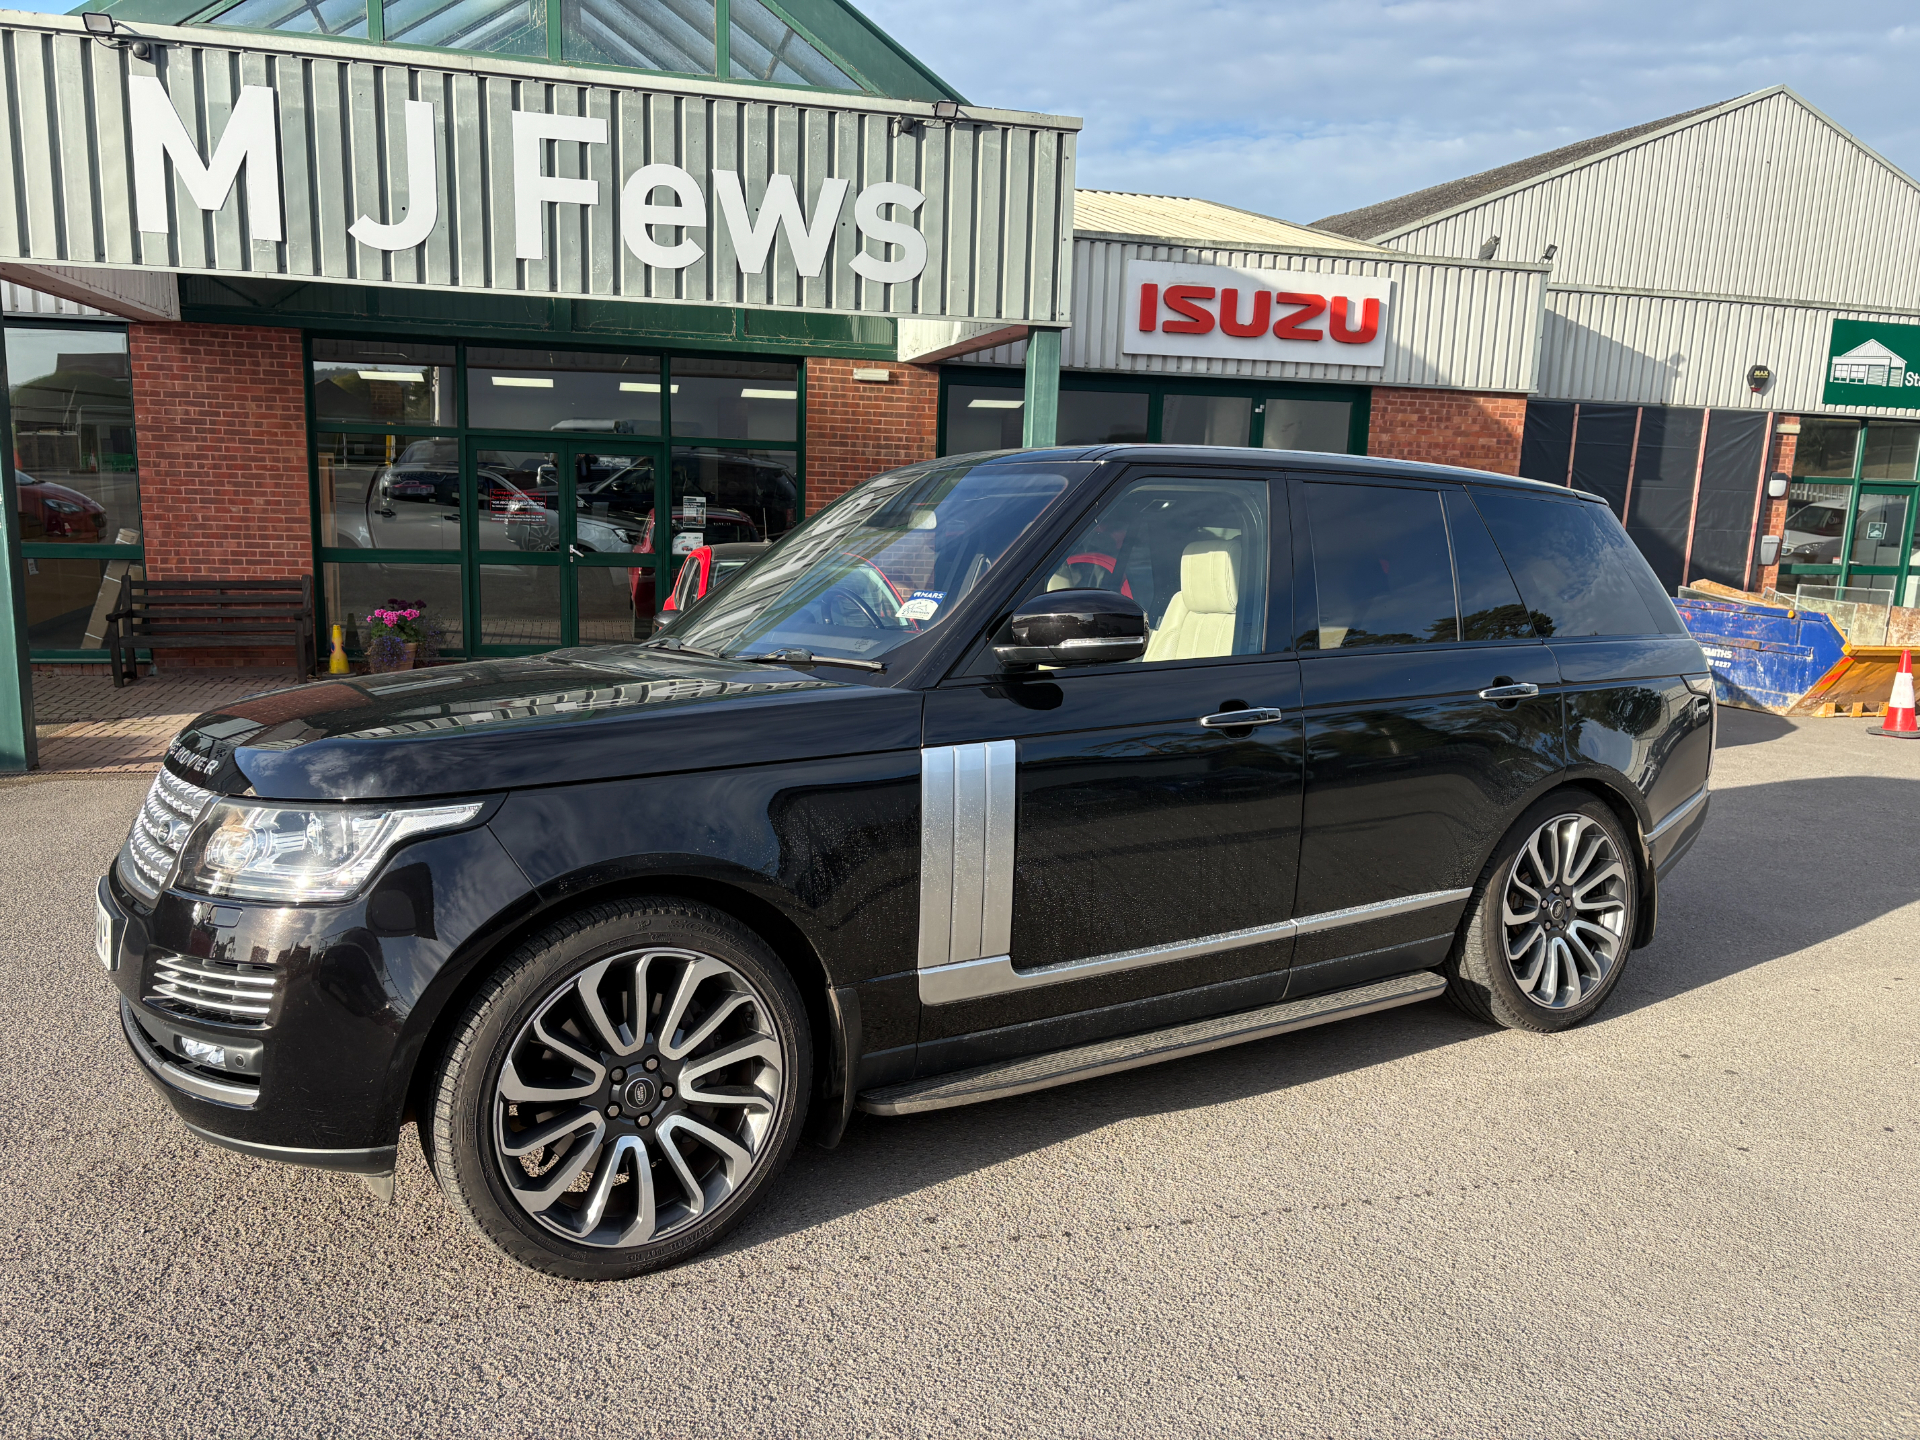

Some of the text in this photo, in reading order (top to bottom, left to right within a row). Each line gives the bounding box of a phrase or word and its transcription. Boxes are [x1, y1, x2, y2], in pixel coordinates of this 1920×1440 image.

[127, 74, 928, 284] M J Fews
[1138, 282, 1380, 344] ISUZU
[1905, 371, 1920, 387] St
